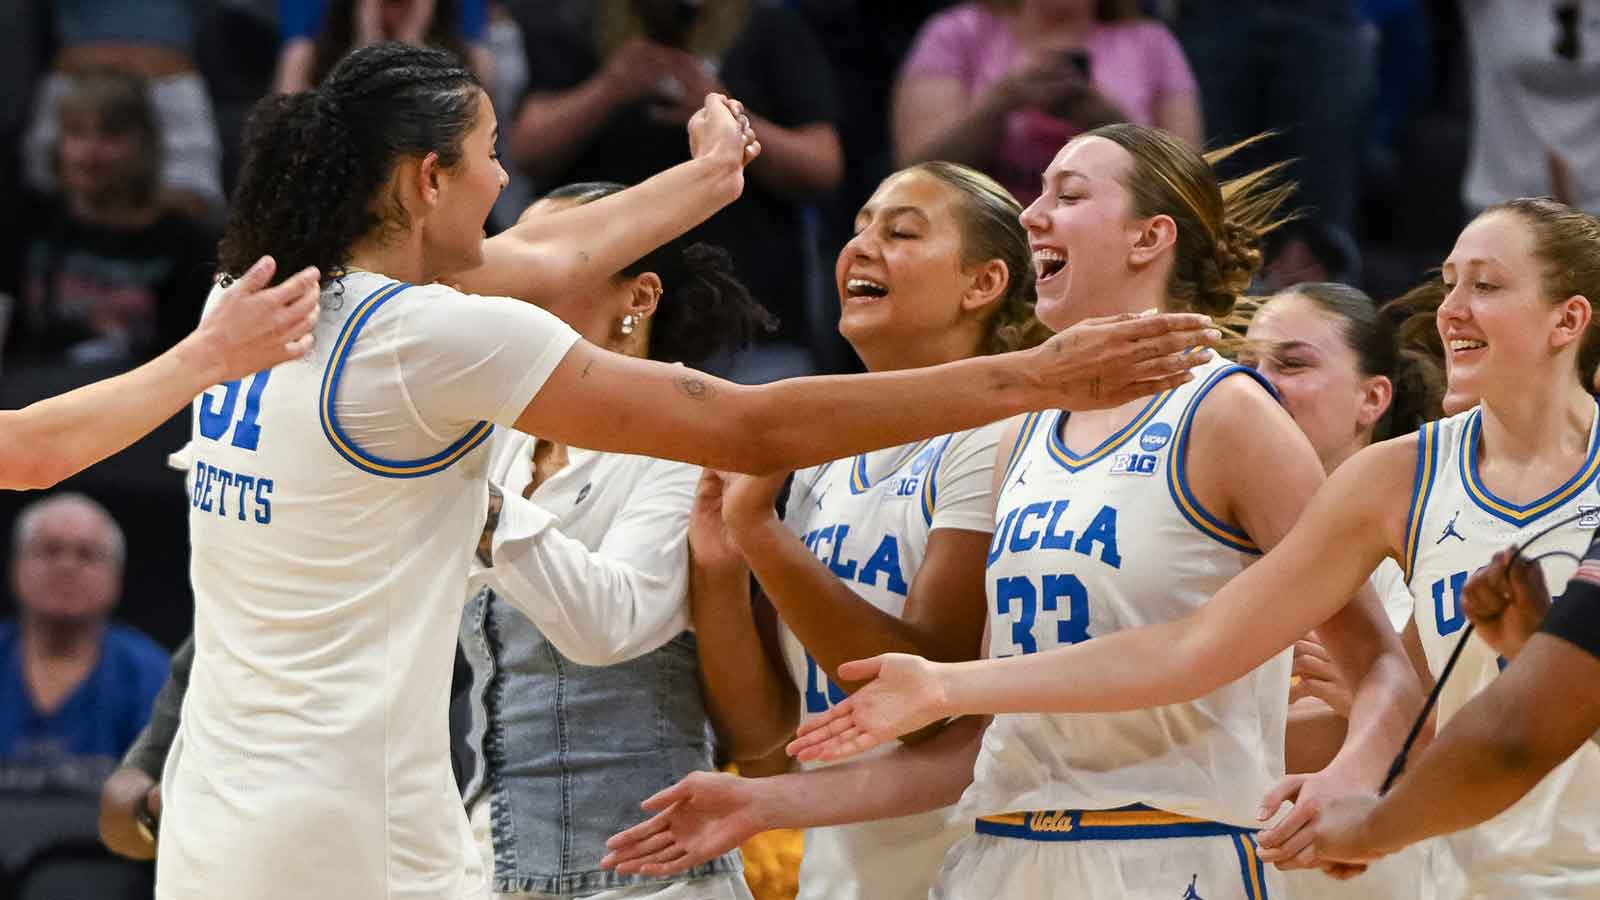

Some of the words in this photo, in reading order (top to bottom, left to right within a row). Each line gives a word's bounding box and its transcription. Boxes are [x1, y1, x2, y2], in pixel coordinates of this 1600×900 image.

[193, 460, 273, 525] BETTS
[801, 524, 908, 596] CLA
[987, 500, 1121, 569] UCLA
[996, 574, 1093, 657] 33
